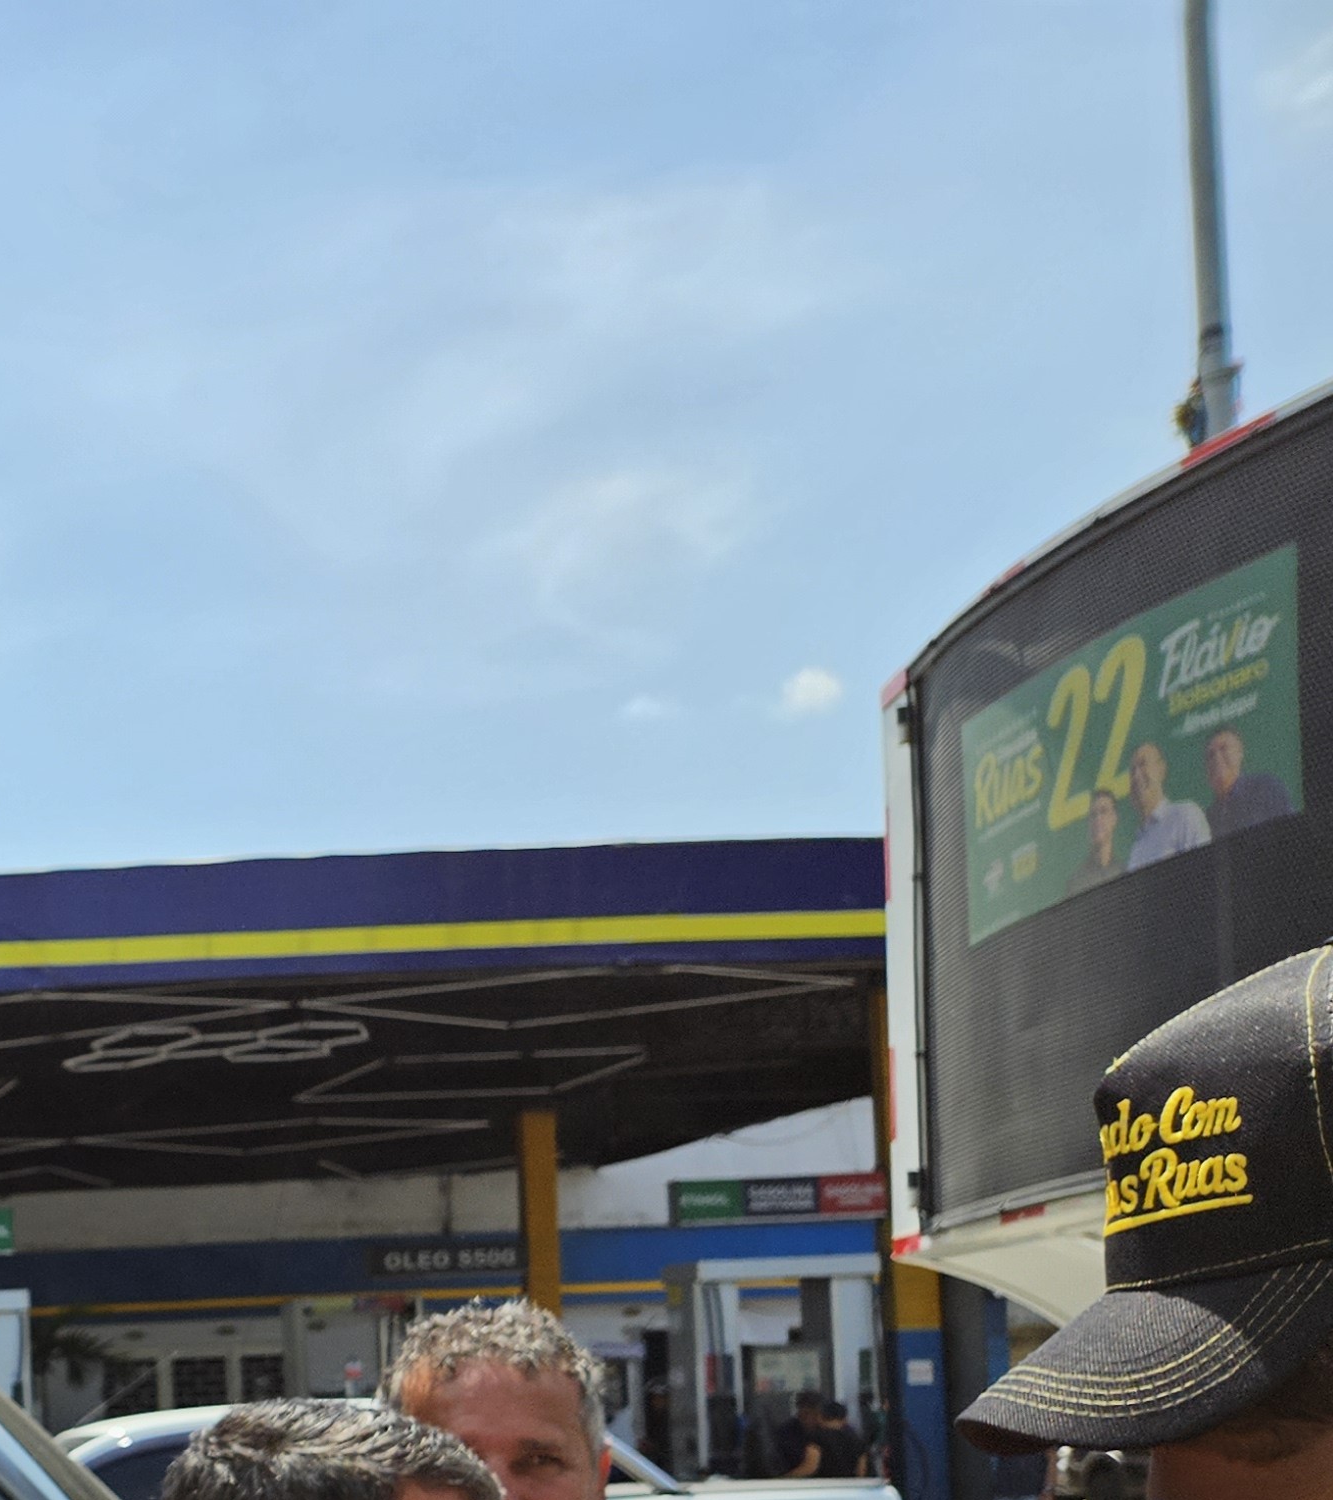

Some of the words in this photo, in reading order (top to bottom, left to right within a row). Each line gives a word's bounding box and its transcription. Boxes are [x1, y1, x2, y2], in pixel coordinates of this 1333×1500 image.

[1046, 634, 1146, 830] 22
[974, 743, 1043, 831] Ruas
[1159, 1086, 1242, 1144] Com
[1139, 1147, 1248, 1210] Ruas
